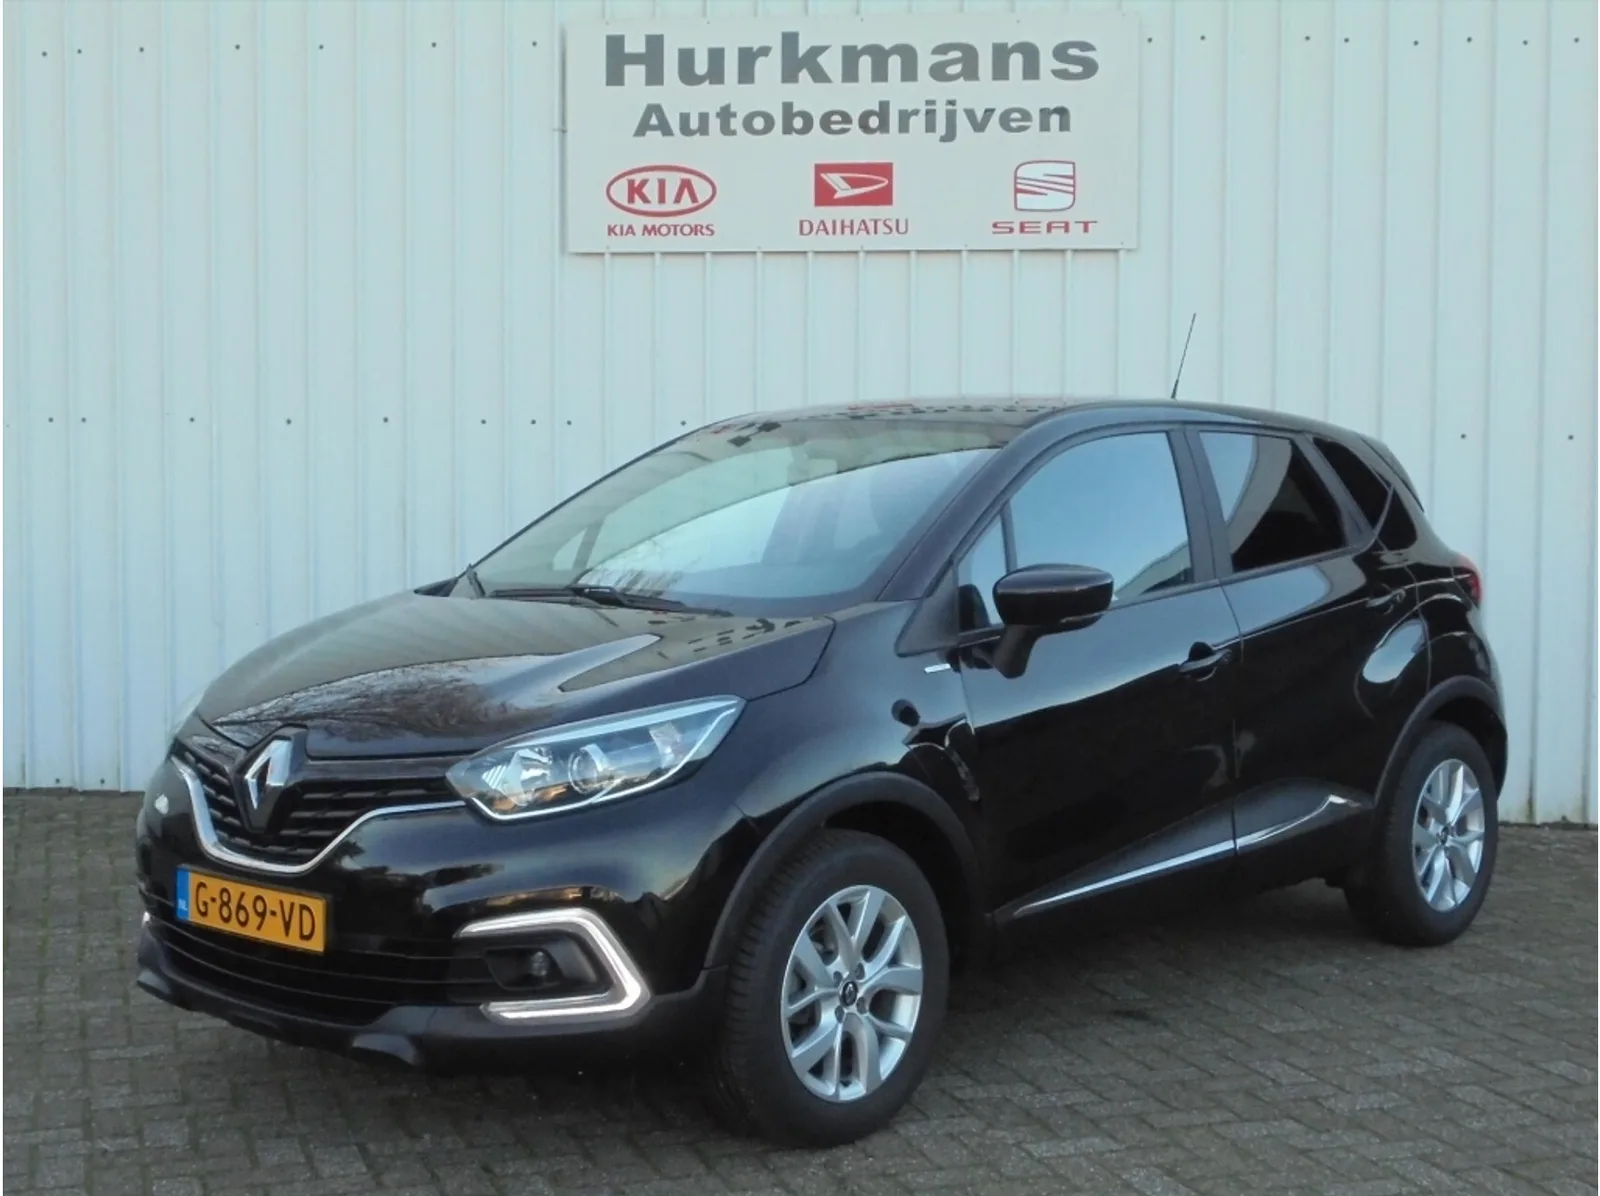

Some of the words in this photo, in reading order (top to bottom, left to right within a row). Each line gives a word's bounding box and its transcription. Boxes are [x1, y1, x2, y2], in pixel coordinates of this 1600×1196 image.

[605, 31, 1099, 87] Hurkmans
[632, 100, 1071, 143] Autobedrijven
[626, 178, 699, 204] KIA
[606, 224, 637, 236] KIA
[641, 223, 716, 237] MOTORS
[798, 218, 909, 236] DAIHATSU
[991, 220, 1098, 235] SEAT
[195, 881, 316, 942] G-869-VD
